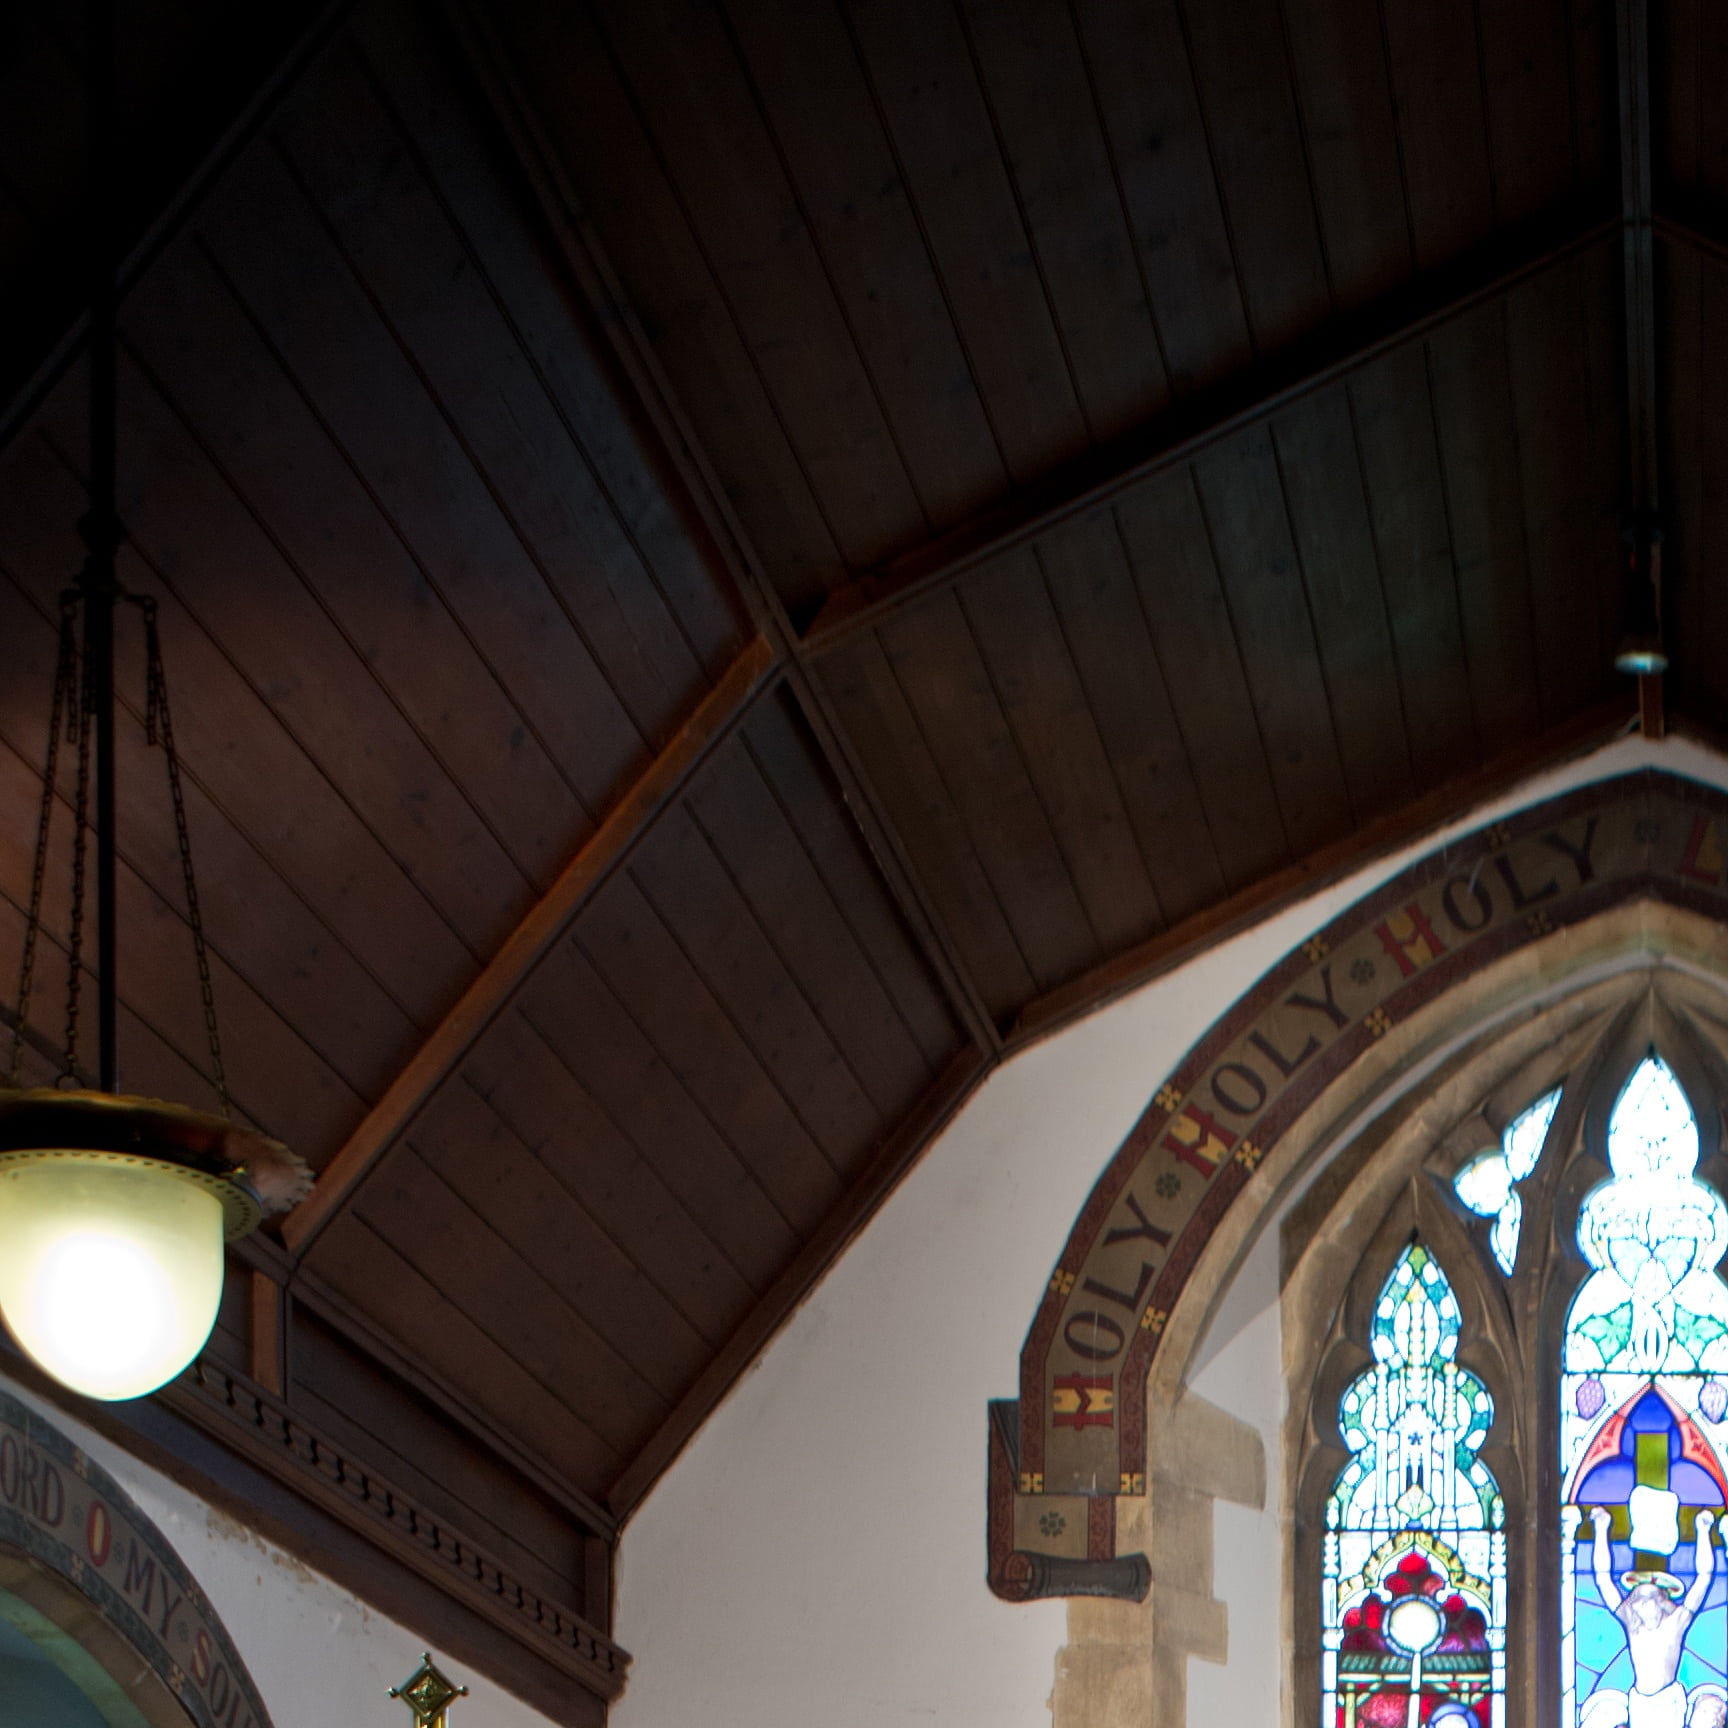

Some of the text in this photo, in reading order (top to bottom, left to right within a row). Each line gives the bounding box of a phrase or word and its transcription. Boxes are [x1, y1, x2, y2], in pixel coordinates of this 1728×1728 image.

[1052, 1192, 1173, 1432] HOLY
[1161, 960, 1350, 1181] HOLY
[1373, 817, 1598, 978] HOLY
[0, 1434, 66, 1528] ORD
[87, 1501, 112, 1567] O
[122, 1536, 183, 1641] MY
